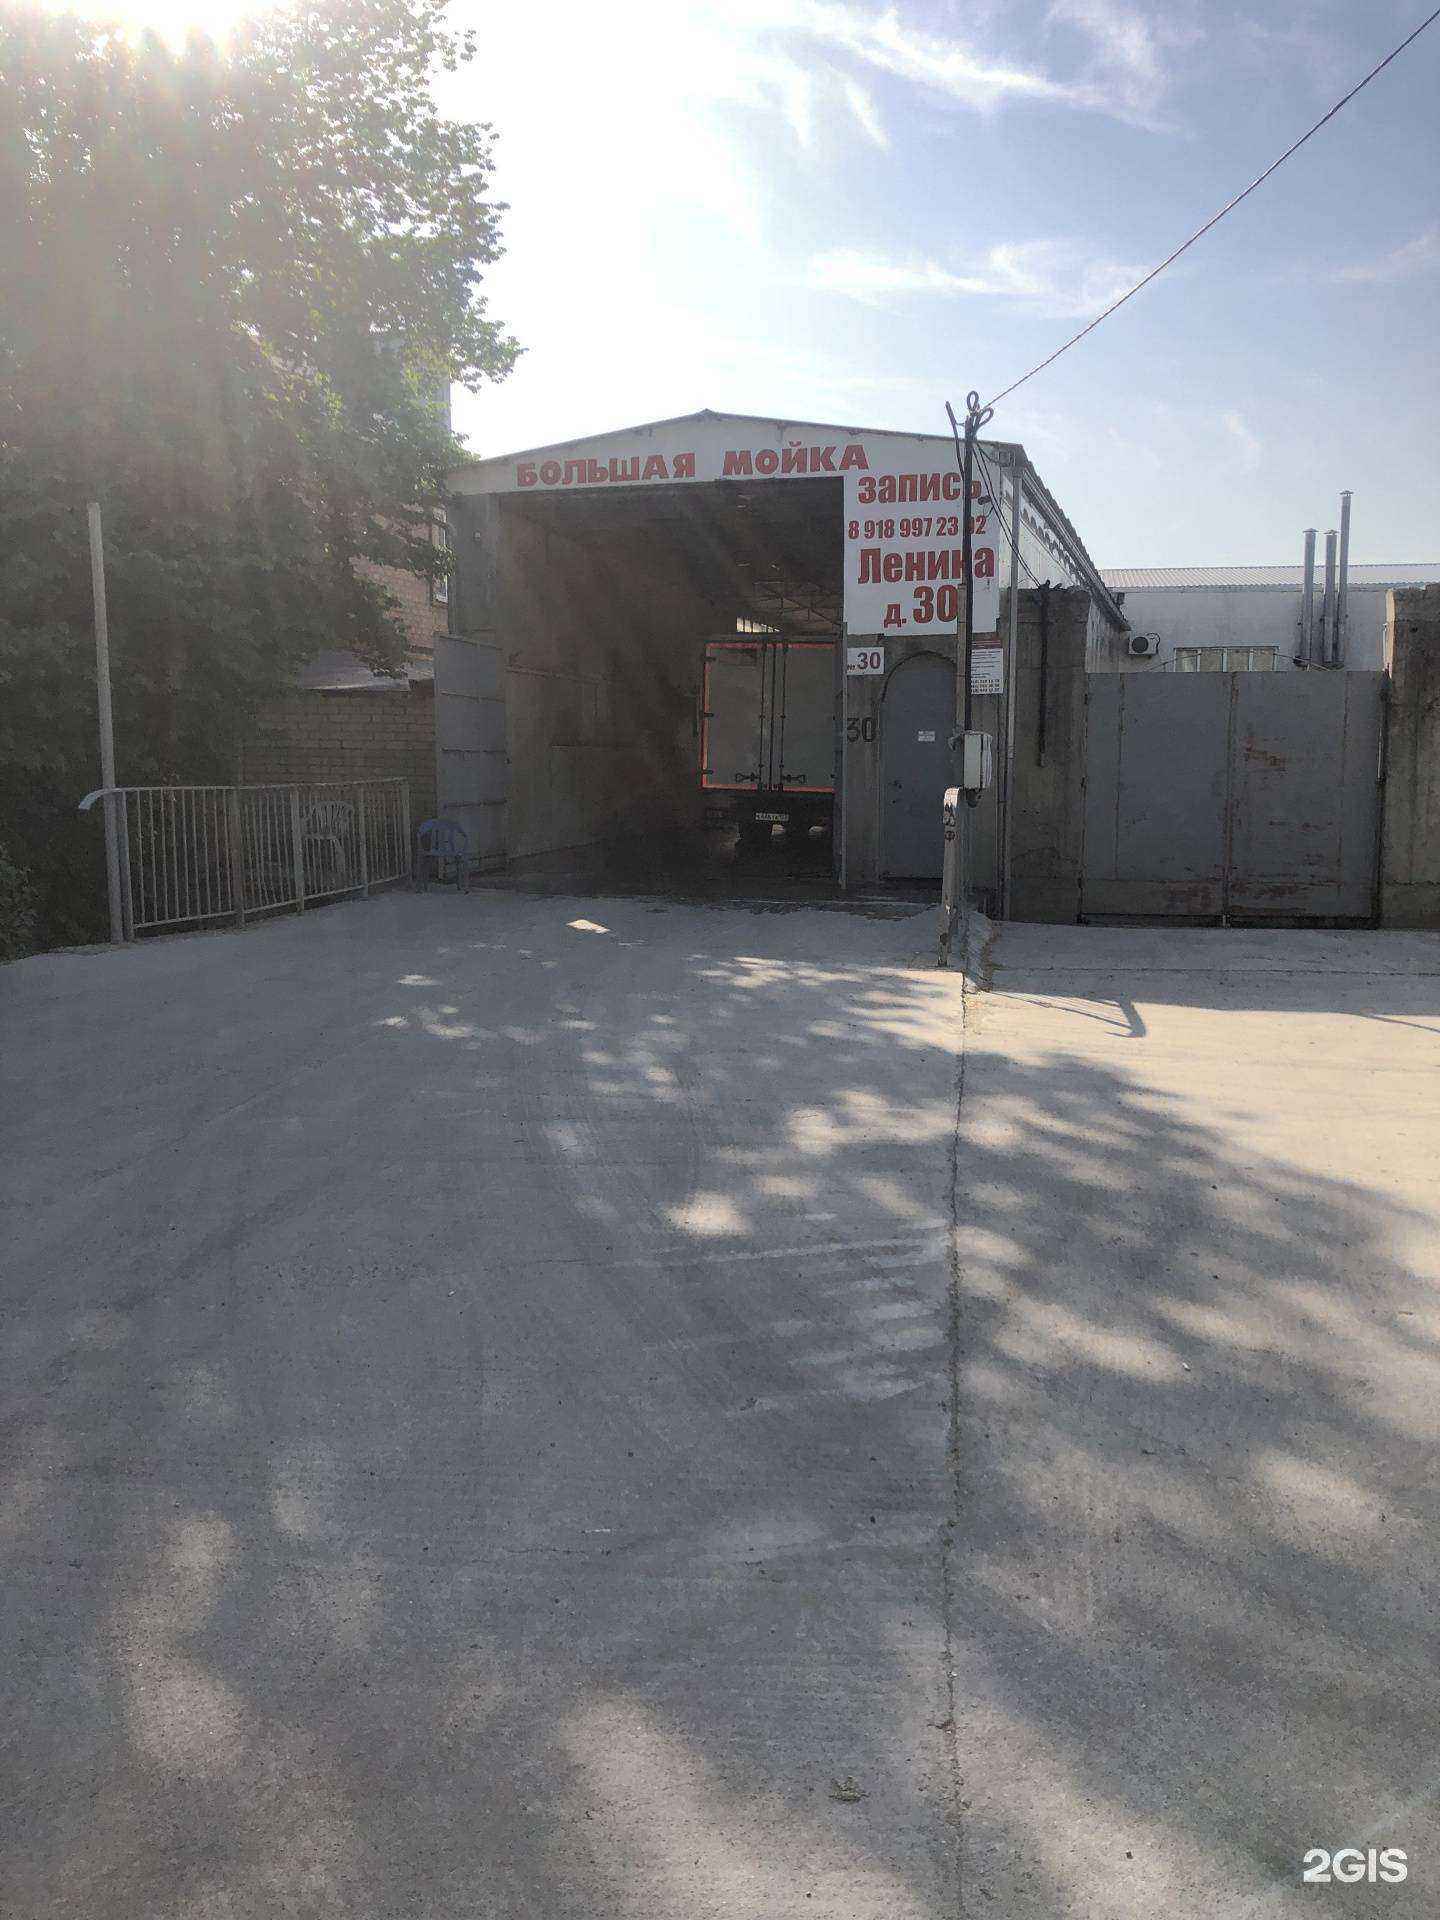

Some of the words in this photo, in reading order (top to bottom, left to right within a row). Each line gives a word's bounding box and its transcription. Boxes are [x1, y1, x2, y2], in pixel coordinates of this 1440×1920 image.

[516, 452, 696, 487] БОЛЬШАЯ
[722, 441, 869, 476] МОЙКА
[848, 520, 860, 540] 8
[864, 518, 894, 539] 918
[900, 517, 933, 538] 997
[883, 603, 907, 628] д.
[913, 584, 958, 623] 30
[857, 652, 881, 670] 30
[847, 717, 877, 743] 30
